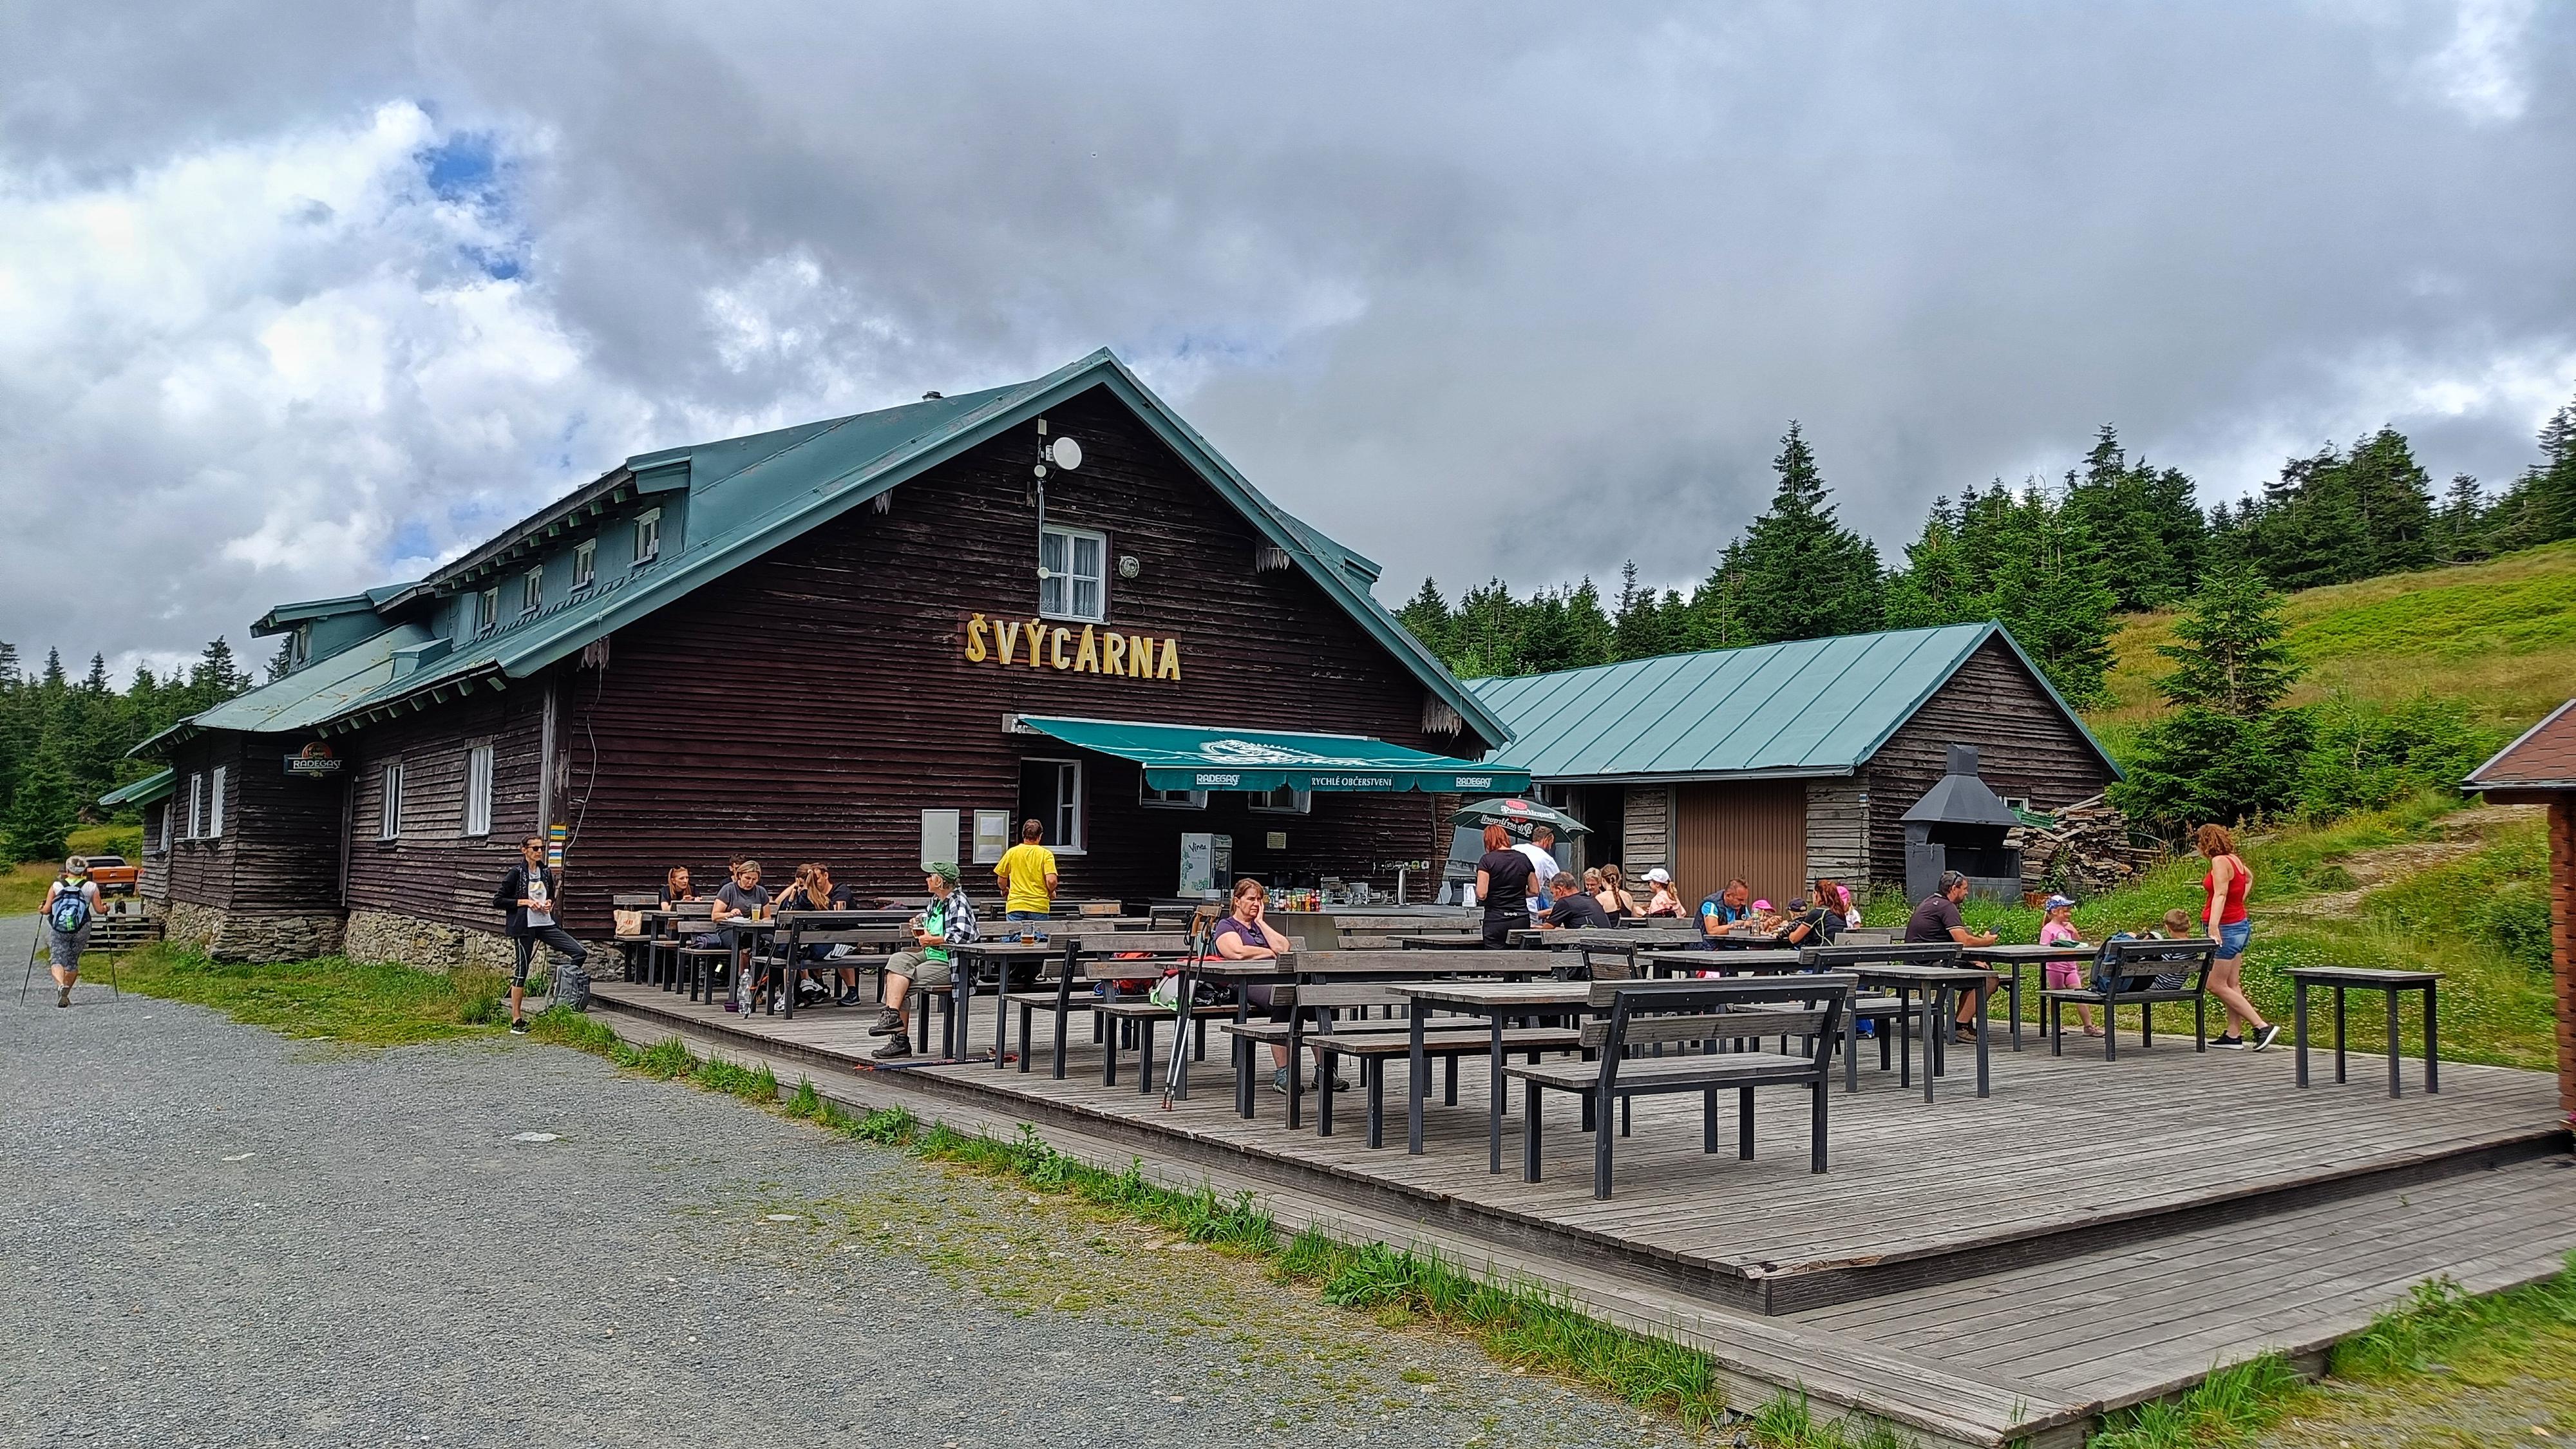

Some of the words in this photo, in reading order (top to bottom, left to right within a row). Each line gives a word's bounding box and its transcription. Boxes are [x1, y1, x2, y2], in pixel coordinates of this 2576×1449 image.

[965, 612, 1181, 681] ŠVÝCÁRNA
[293, 760, 342, 770] RADEGAST
[1196, 773, 1240, 786] RADEGAST
[1311, 775, 1340, 786] RYCHLÉ
[1341, 775, 1392, 786] OBČERSTVENÍ
[1456, 777, 1492, 788] RADEGAST
